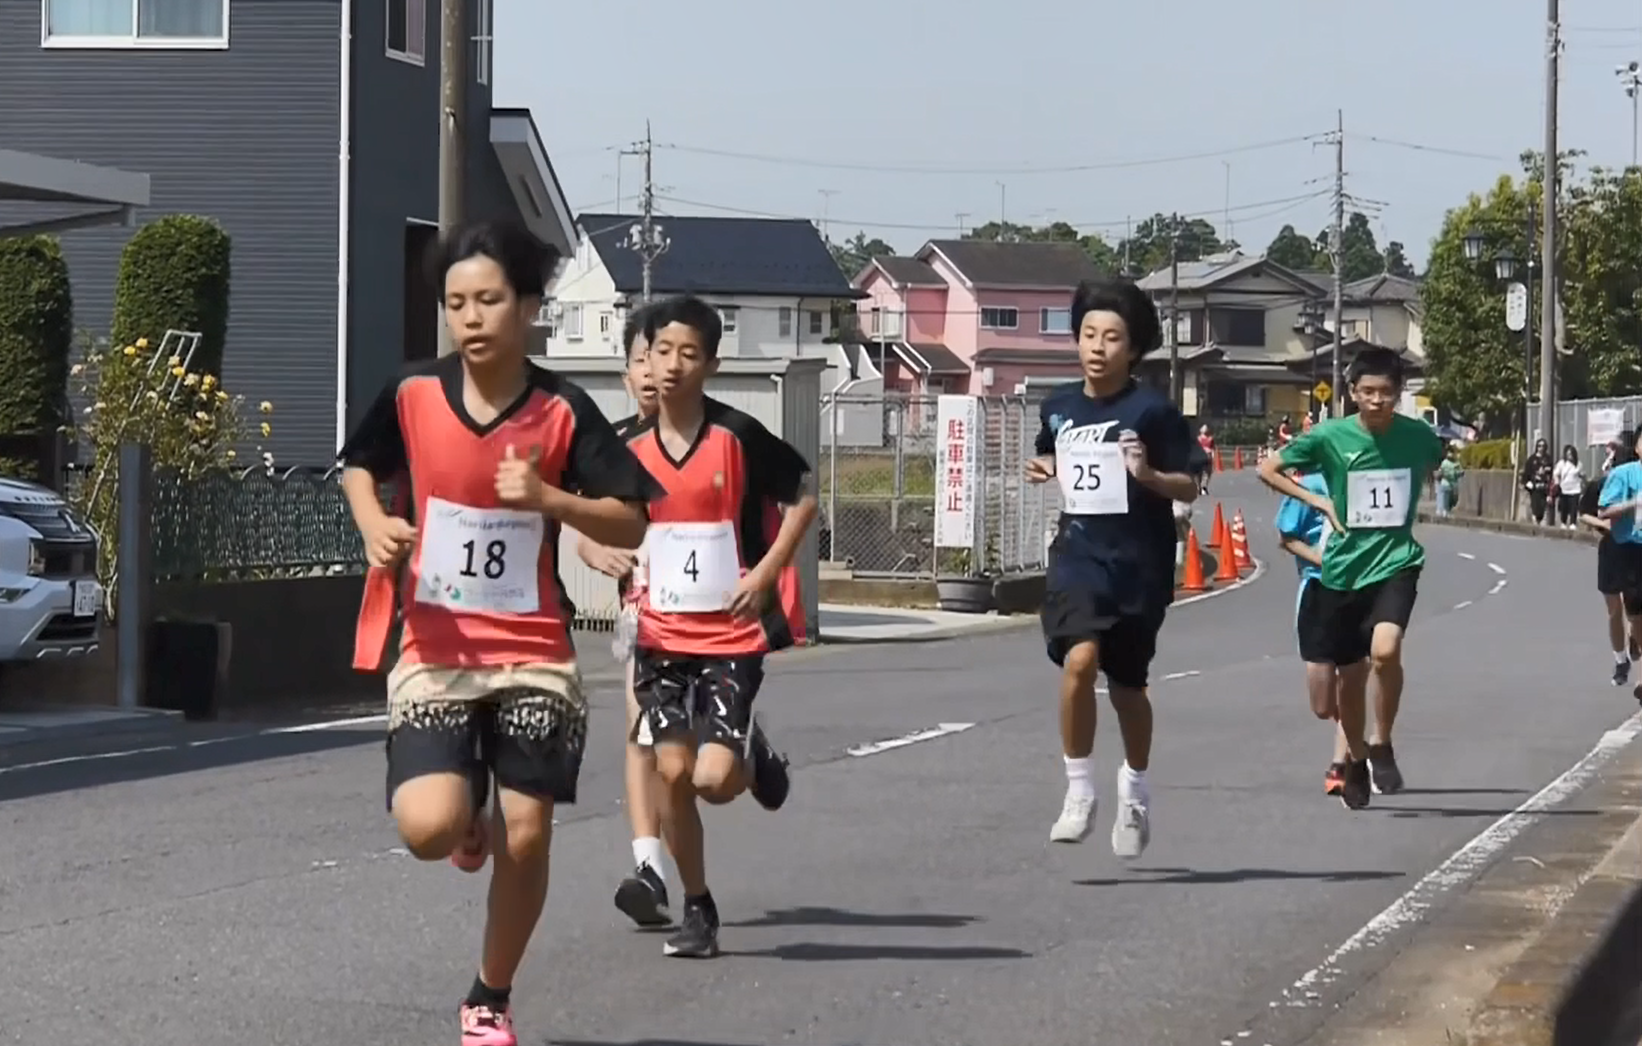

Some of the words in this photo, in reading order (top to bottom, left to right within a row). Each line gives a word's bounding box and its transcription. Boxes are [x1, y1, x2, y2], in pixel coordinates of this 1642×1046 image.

[947, 419, 965, 512] 駐車禁止
[1073, 464, 1101, 491] 25
[1369, 486, 1393, 509] 11
[459, 539, 507, 580] 18
[683, 549, 699, 583] 4
